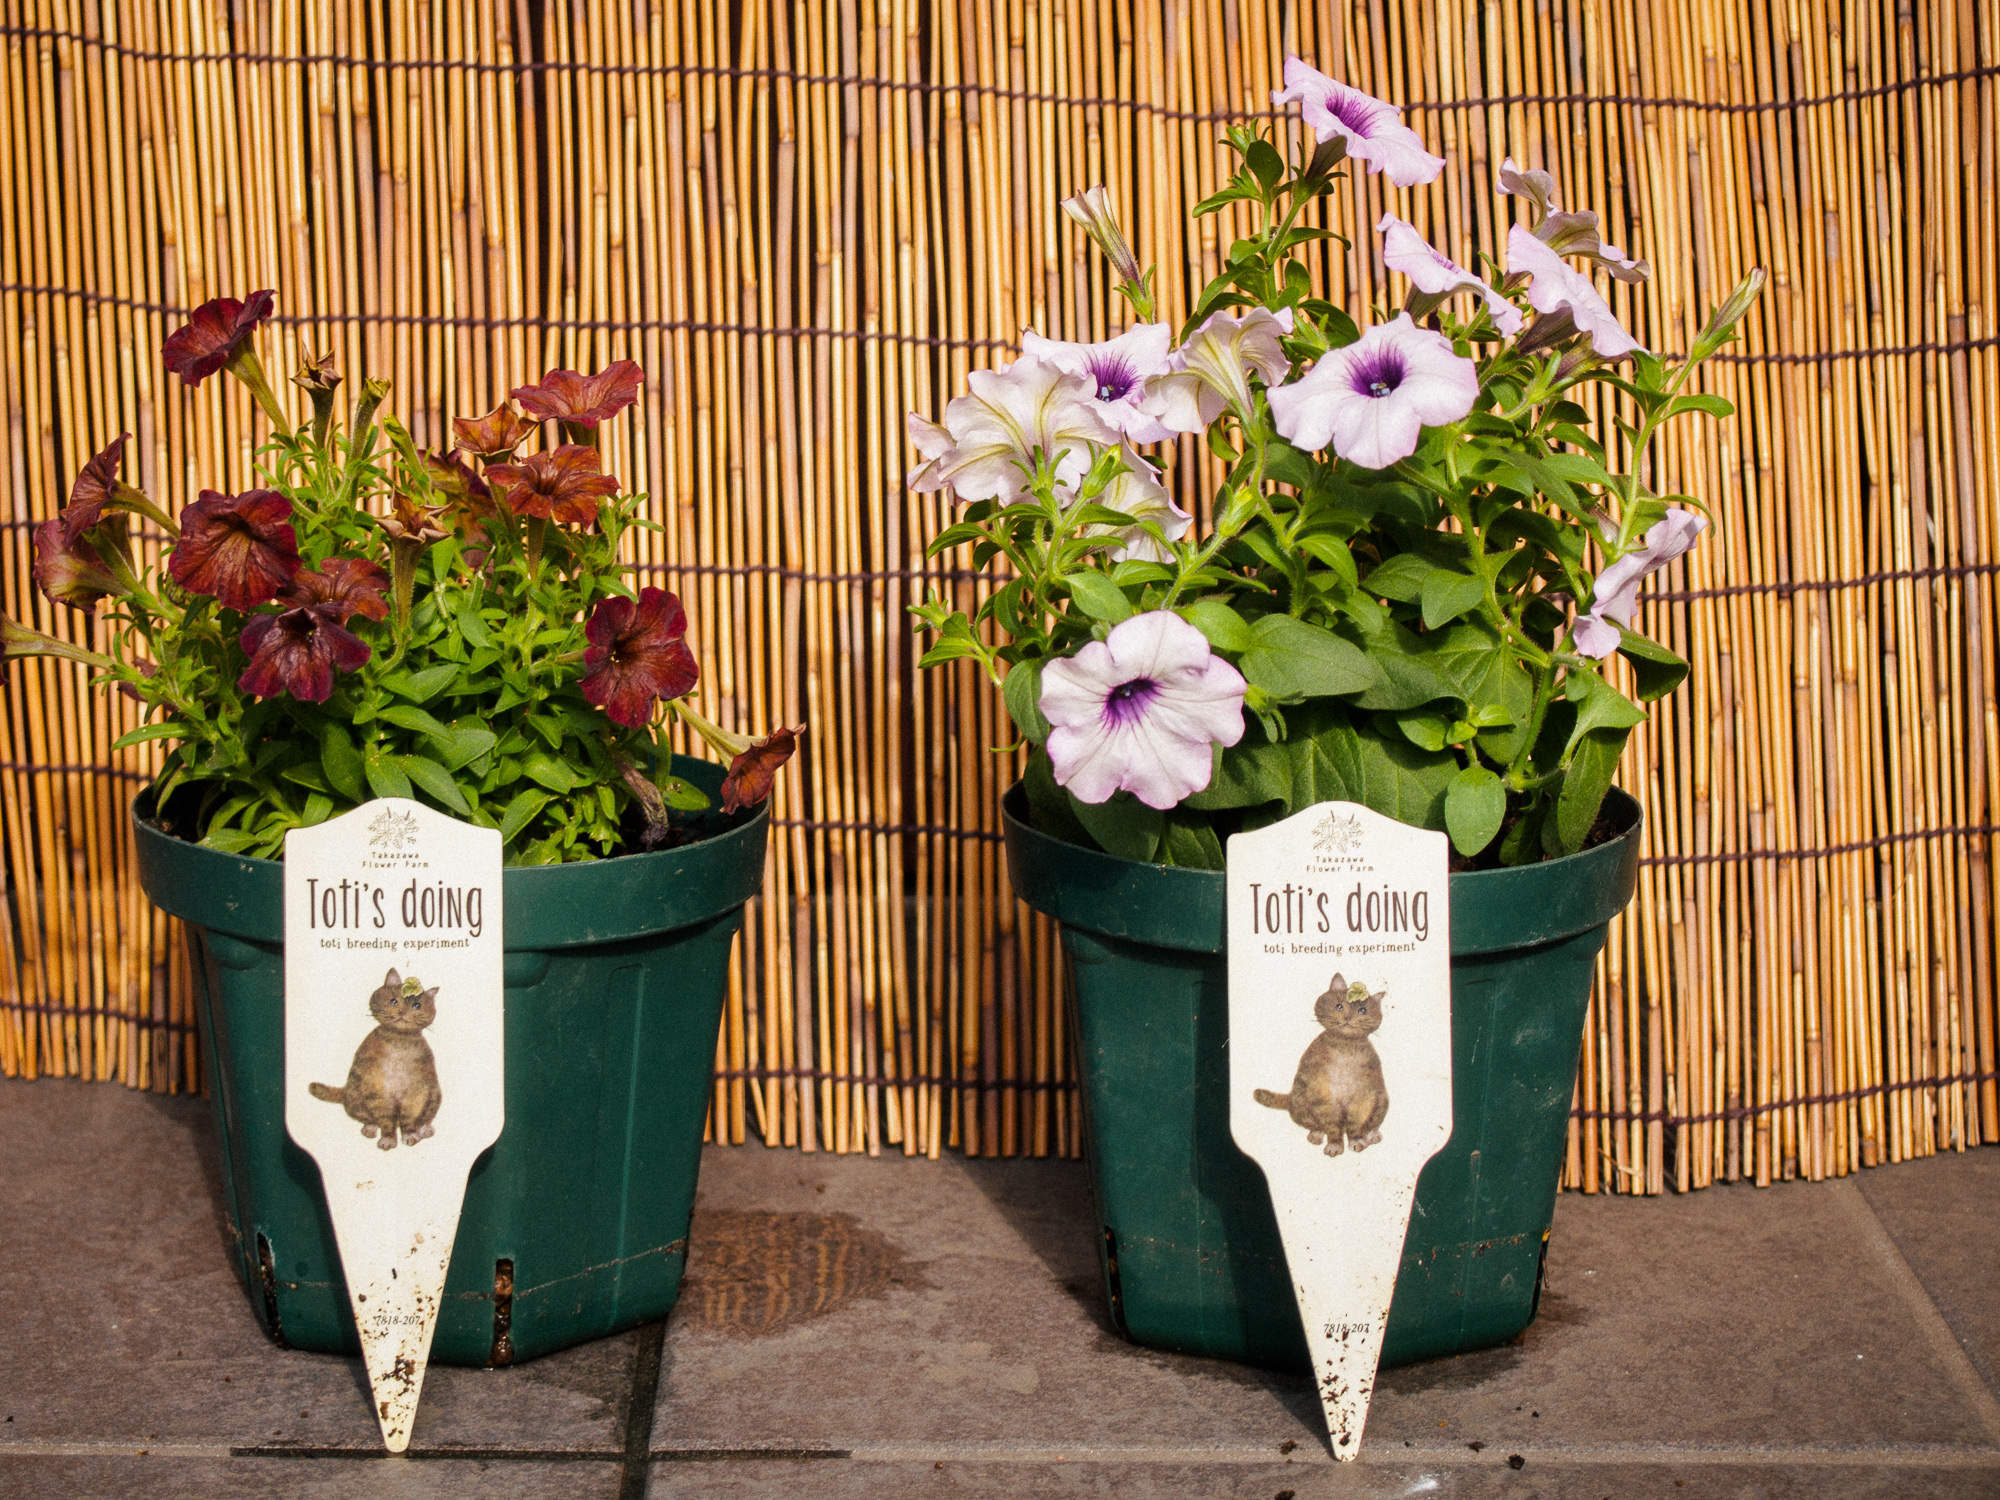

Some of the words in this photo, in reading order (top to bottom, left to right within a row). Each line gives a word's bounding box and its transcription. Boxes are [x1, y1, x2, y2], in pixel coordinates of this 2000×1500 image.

[372, 851, 419, 859] Takazawa
[1306, 865, 1341, 873] Flower
[307, 878, 385, 929] Toti's
[1250, 883, 1330, 934] Toti's
[321, 938, 341, 949] toti
[347, 937, 398, 951] breeding
[403, 937, 470, 950] experiment
[1264, 943, 1285, 954] toti
[1291, 942, 1342, 957] breeding
[1348, 942, 1416, 955] experiment
[375, 1315, 421, 1325] 7818-207
